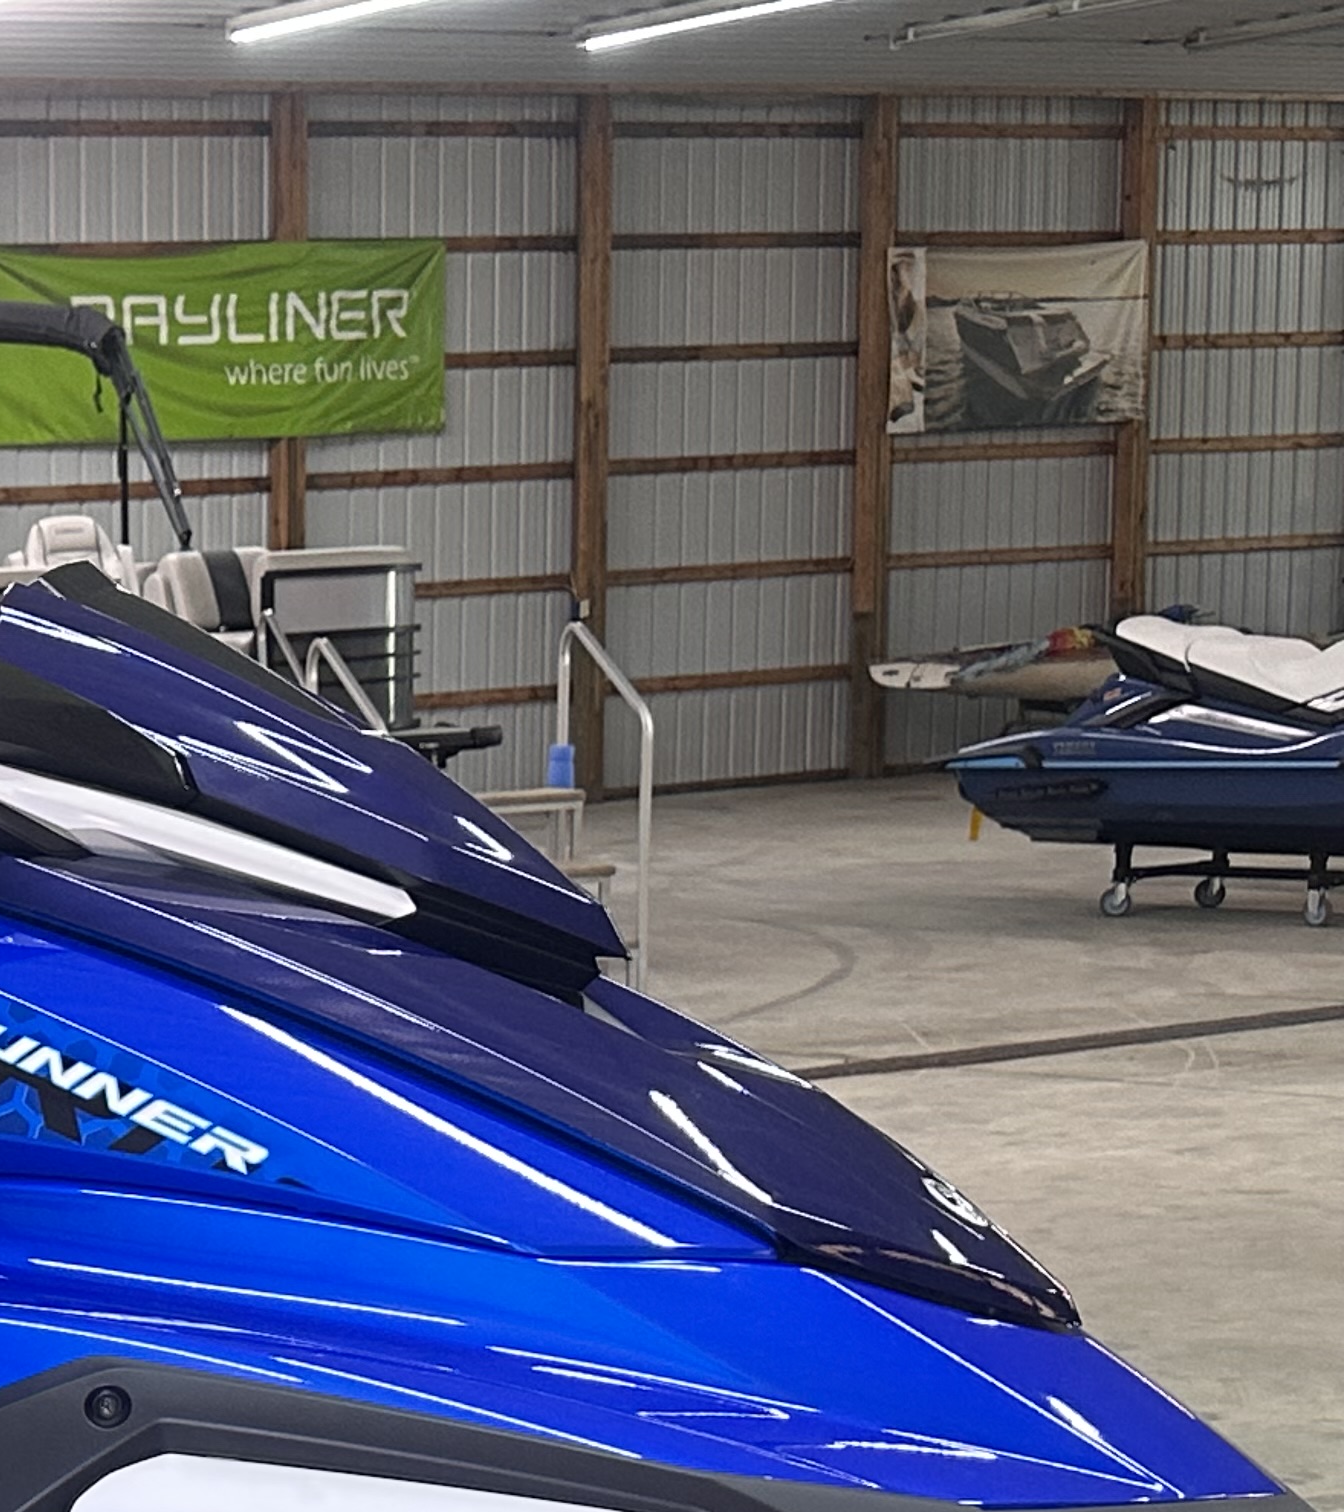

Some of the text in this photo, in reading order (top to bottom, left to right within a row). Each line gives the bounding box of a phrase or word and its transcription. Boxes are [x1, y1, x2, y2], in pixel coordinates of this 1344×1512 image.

[224, 355, 410, 386] where fun lives
